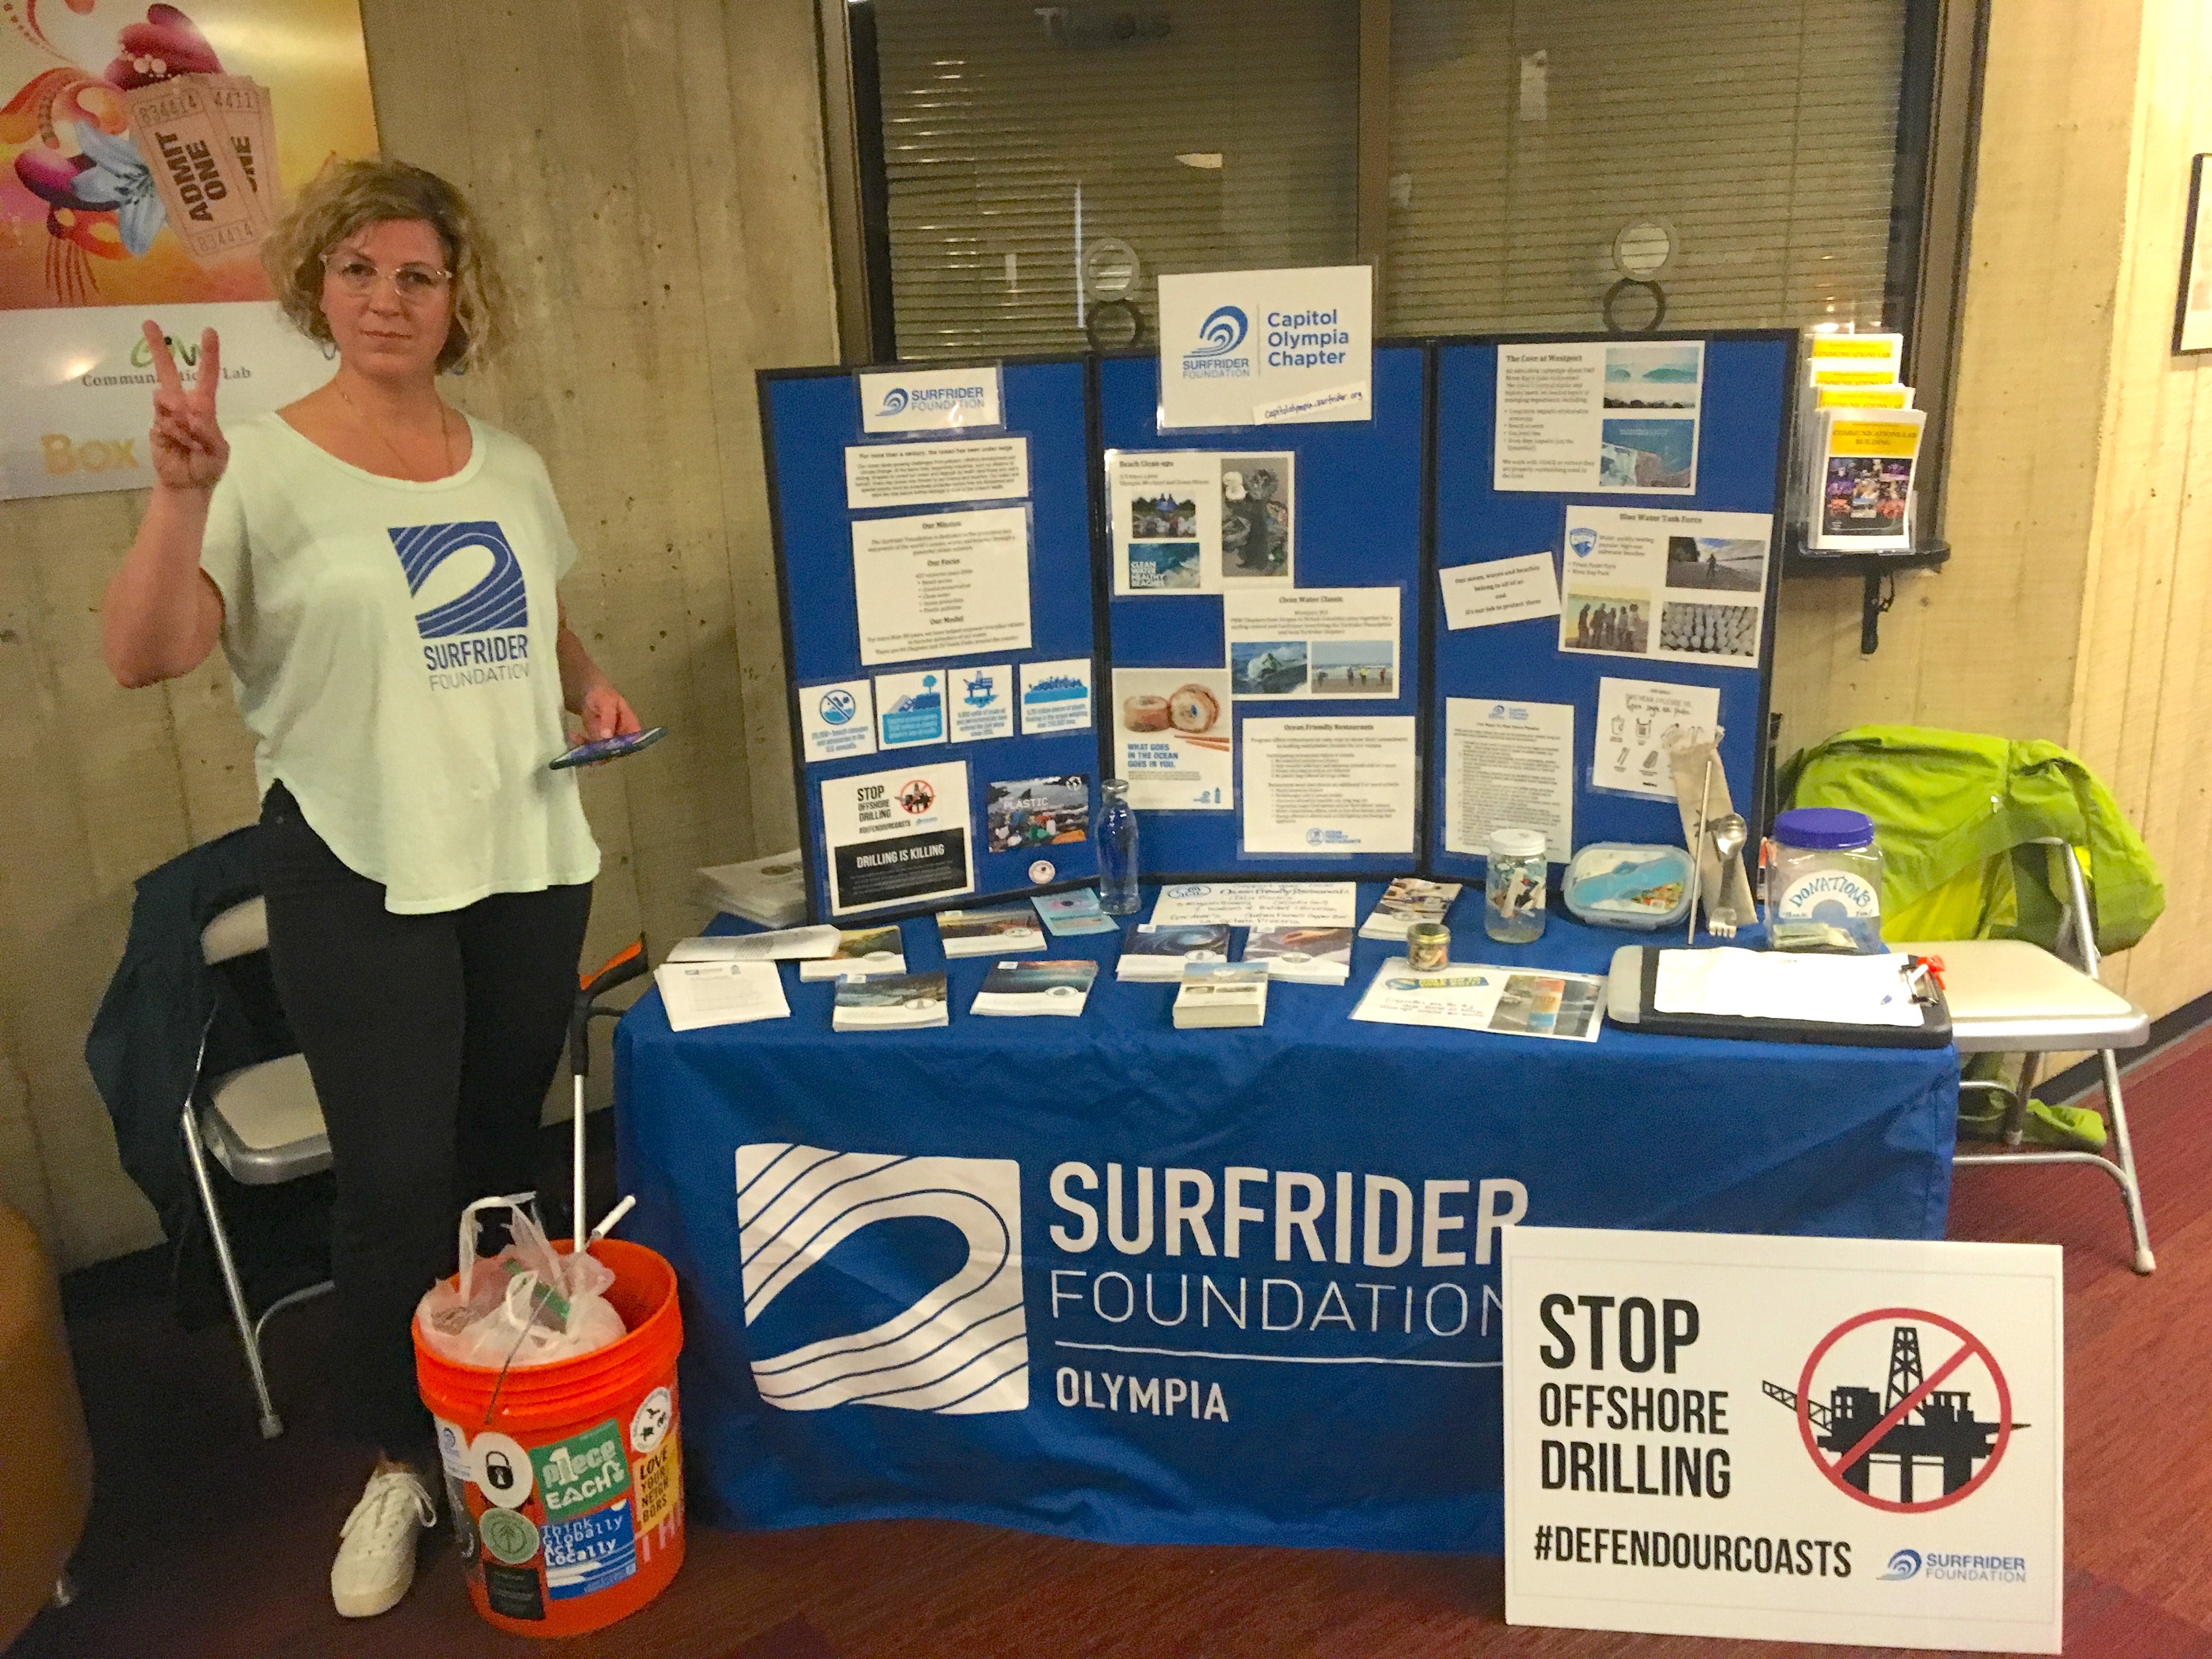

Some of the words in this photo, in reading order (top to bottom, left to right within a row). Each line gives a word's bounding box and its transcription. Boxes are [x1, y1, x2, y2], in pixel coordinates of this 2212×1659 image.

[213, 92, 253, 108] 4411
[155, 131, 214, 221] ADMIT
[185, 139, 227, 200] ONE
[230, 136, 257, 193] NE
[1267, 309, 1338, 329] Capitol
[1268, 329, 1350, 349] Olympia
[1183, 358, 1249, 370] SURFRIDER
[1268, 351, 1346, 368] Chapter
[223, 366, 250, 381] Lab
[1183, 369, 1250, 380] FOUNDATION
[911, 387, 984, 401] SURFRIDER
[911, 397, 985, 411] FOUNDATION
[424, 634, 528, 671] SURFRIDER
[857, 785, 884, 802] STOP
[858, 799, 889, 811] OFFSHORE
[1003, 797, 1048, 810] PLASTIC
[859, 809, 891, 822] DRILLING
[856, 851, 898, 868] DRILLING
[900, 849, 909, 862] IS
[910, 843, 945, 860] KILLING
[1789, 876, 1871, 907] DONATIONS
[1048, 1161, 1529, 1268] SURFRIDER
[1539, 1293, 1700, 1374] STOP
[1056, 1365, 1229, 1423] OLYMPIA
[1539, 1382, 1729, 1436] OFFSHORE
[640, 1445, 668, 1480] LOVE
[1541, 1440, 1731, 1499] DRILLING
[545, 1462, 613, 1510] EACH
[641, 1465, 666, 1492] YOUR
[643, 1493, 667, 1523] BORS
[1534, 1525, 1852, 1578] #DEFENDOURCOASTS
[1926, 1551, 2025, 1571] SURFRIDER
[1925, 1567, 2026, 1584] FOUNDATION
